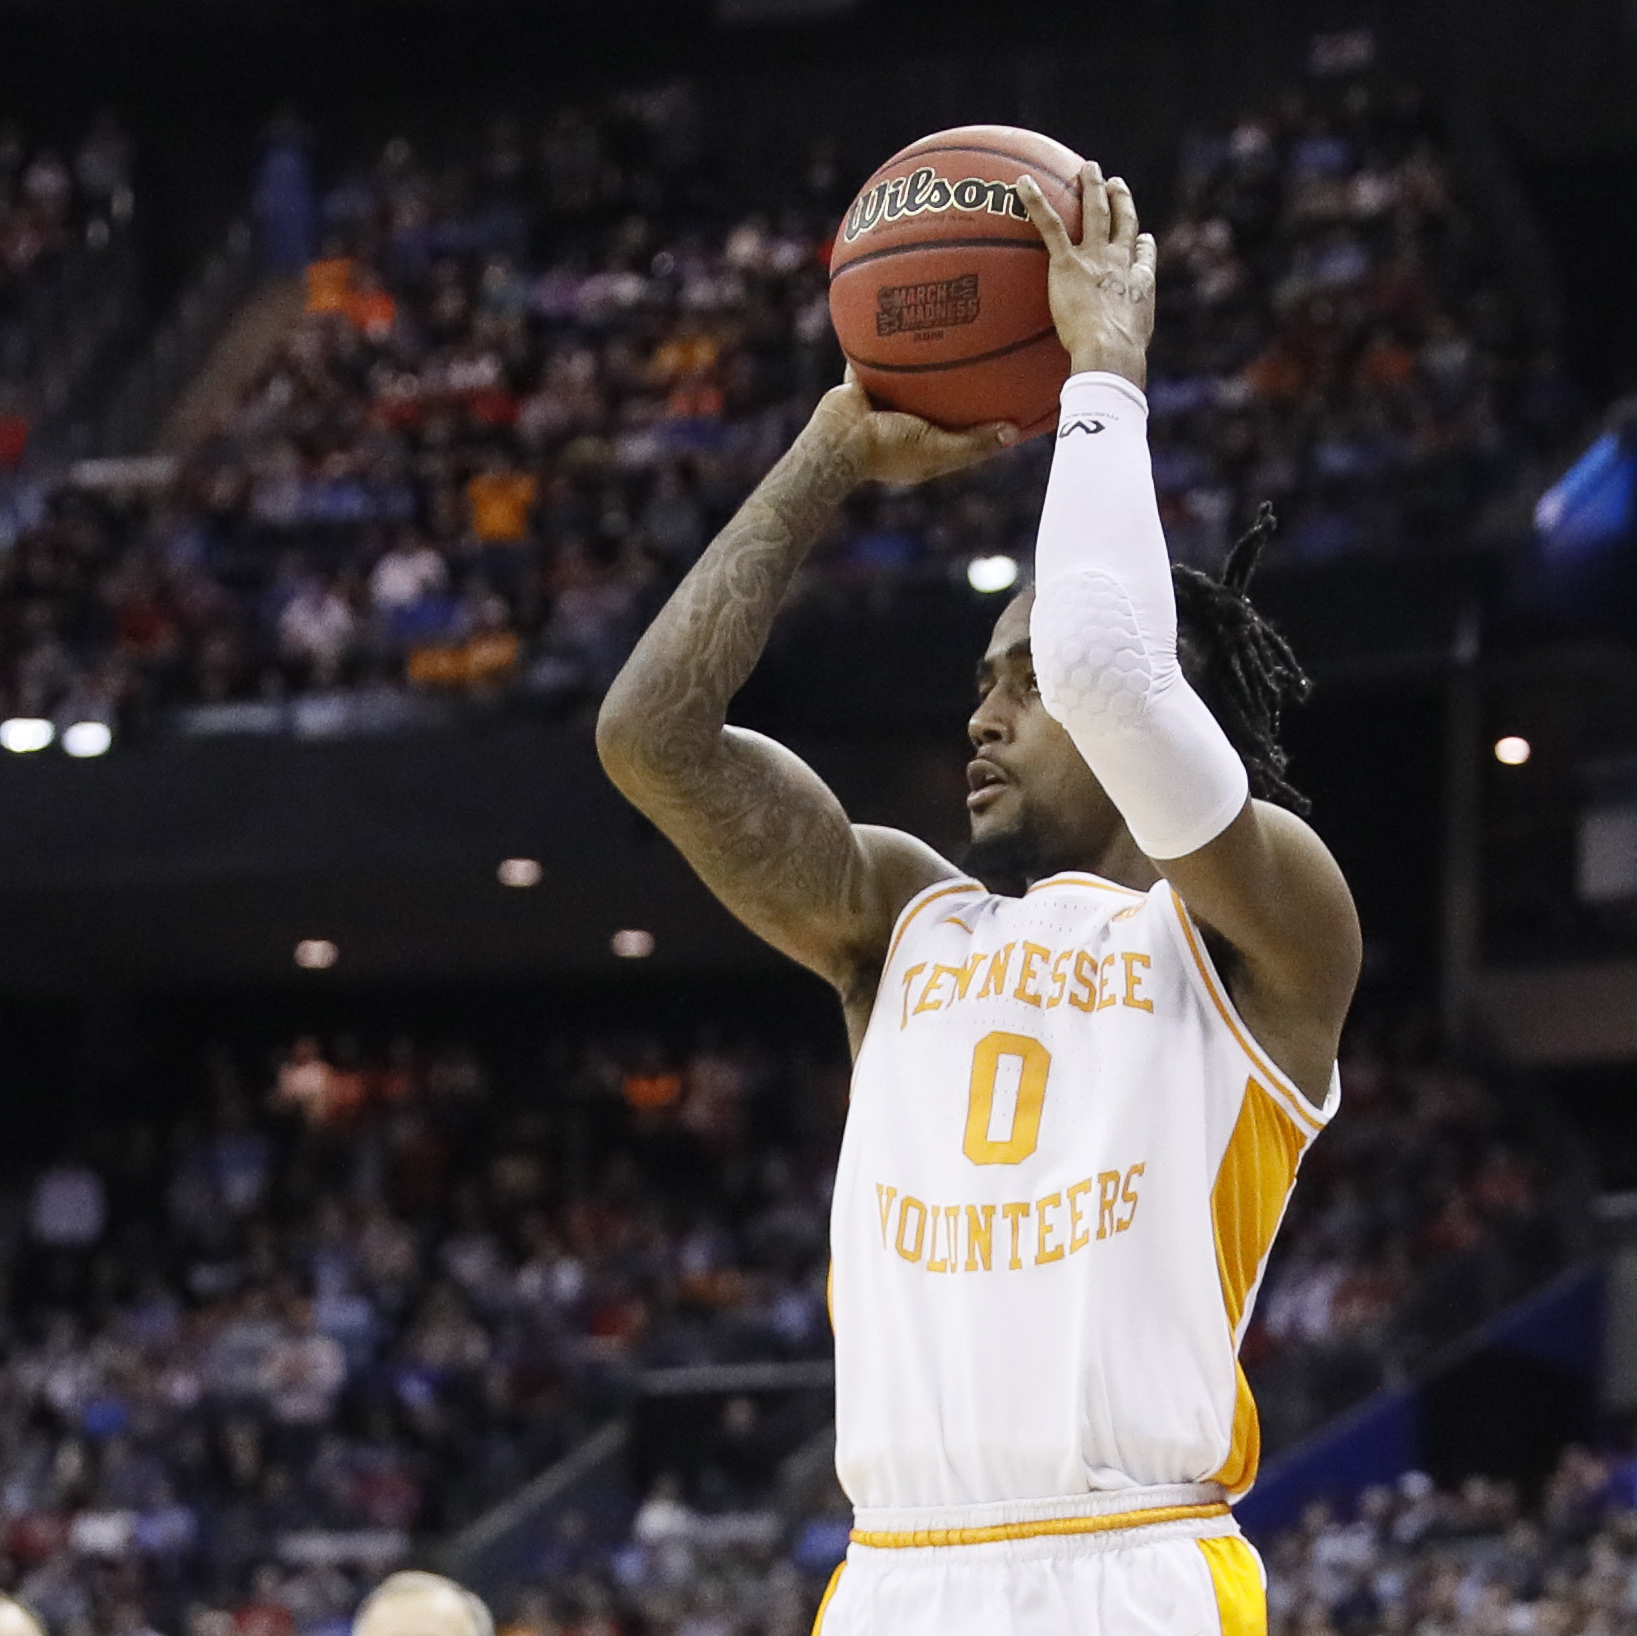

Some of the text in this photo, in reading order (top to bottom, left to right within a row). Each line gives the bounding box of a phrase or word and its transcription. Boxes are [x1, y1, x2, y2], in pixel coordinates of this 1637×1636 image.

[844, 167, 1033, 243] Wilson
[962, 1030, 1052, 1166] 0
[876, 1162, 1146, 1274] VOLUNTEERS
